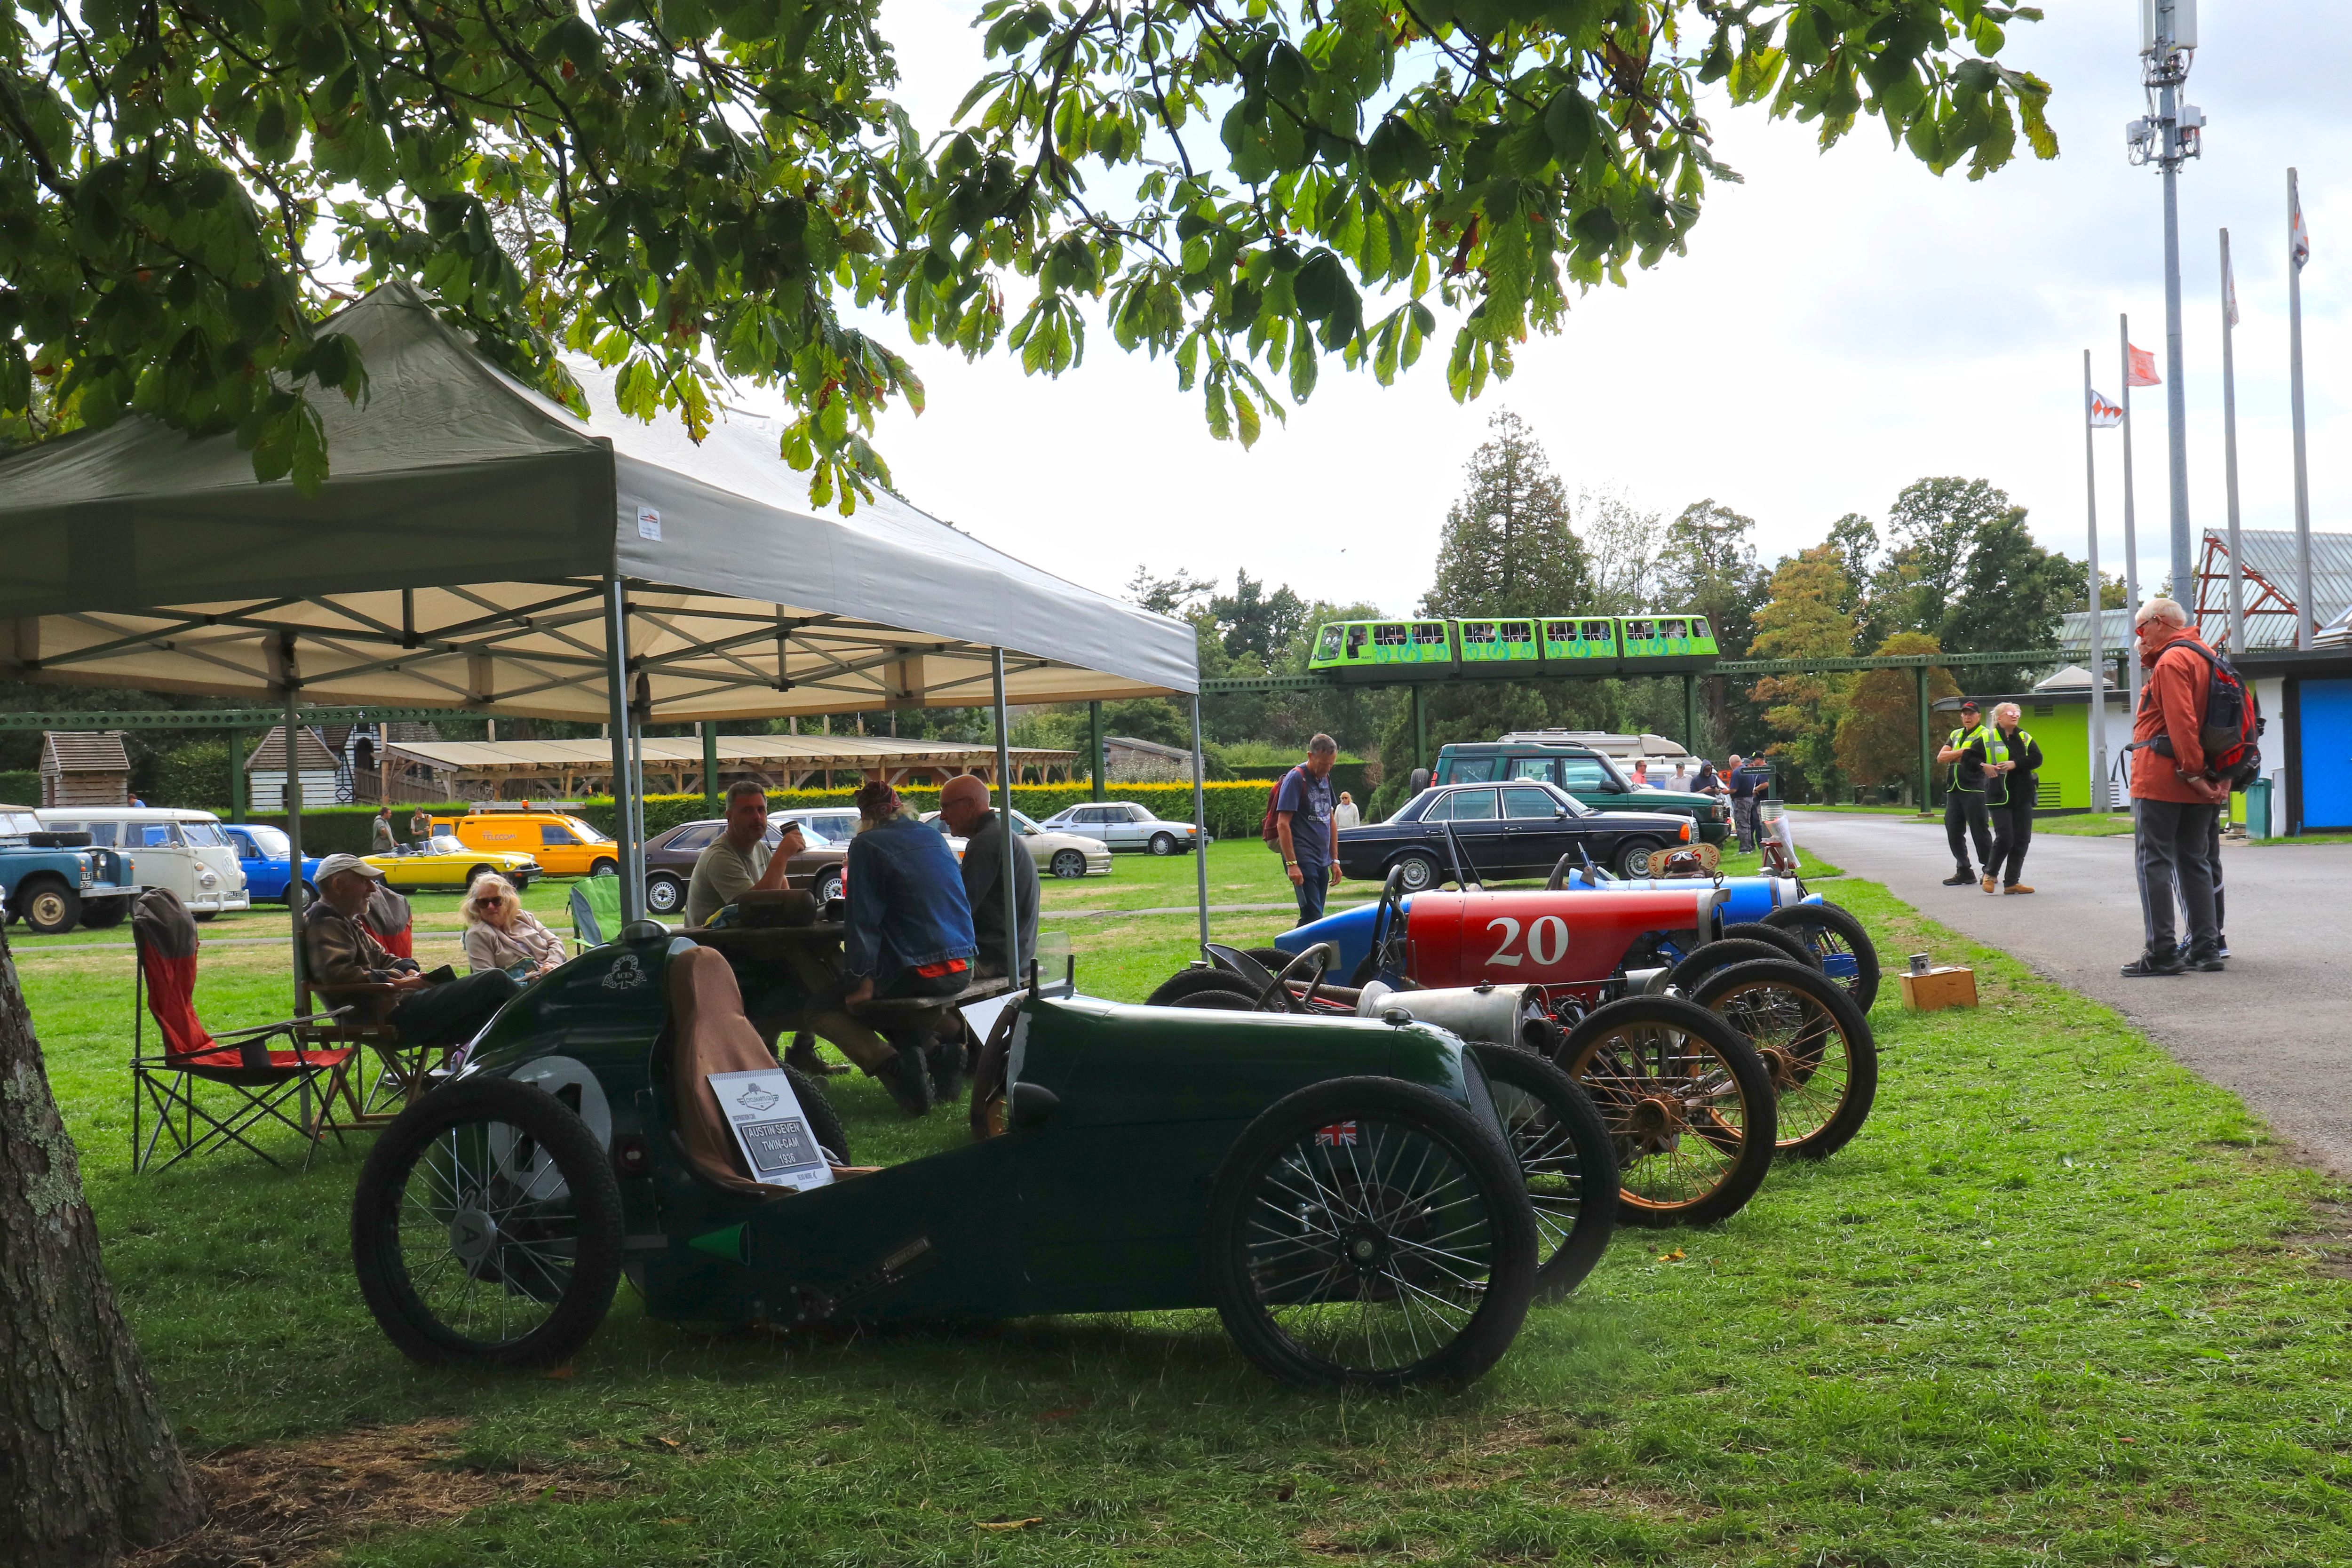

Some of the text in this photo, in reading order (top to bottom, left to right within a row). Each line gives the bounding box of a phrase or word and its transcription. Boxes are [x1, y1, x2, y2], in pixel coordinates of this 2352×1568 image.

[1704, 846, 1716, 866] DEVIL
[1485, 915, 1569, 967] 20
[613, 955, 637, 970] AIRFIELD
[615, 971, 634, 979] ACES
[748, 1122, 800, 1138] AUSTIN SEVEN
[762, 1138, 799, 1151] TWIN-CAM
[779, 1153, 796, 1164] 1936
[461, 1225, 481, 1245] A
